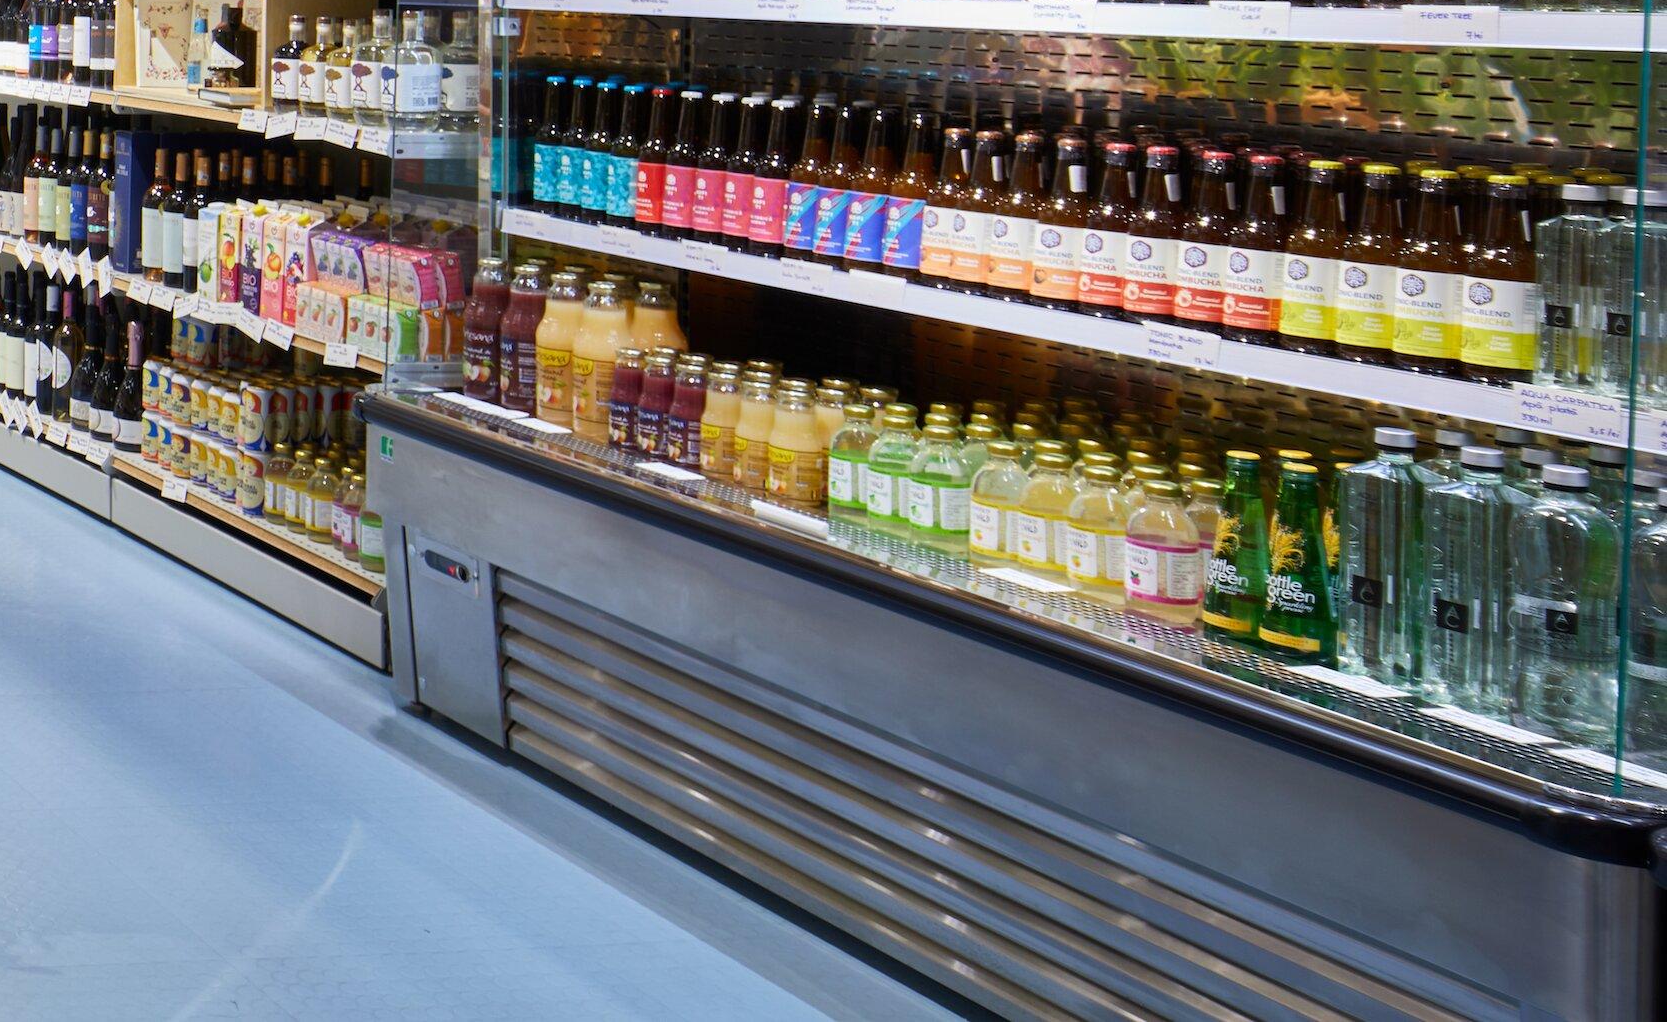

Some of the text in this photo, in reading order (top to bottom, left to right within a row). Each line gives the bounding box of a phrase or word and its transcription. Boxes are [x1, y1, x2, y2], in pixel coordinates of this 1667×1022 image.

[1420, 11, 1473, 21] FEVER TREE
[242, 273, 257, 286] BIO
[264, 281, 279, 292] BIO
[1521, 389, 1550, 402] AQUA
